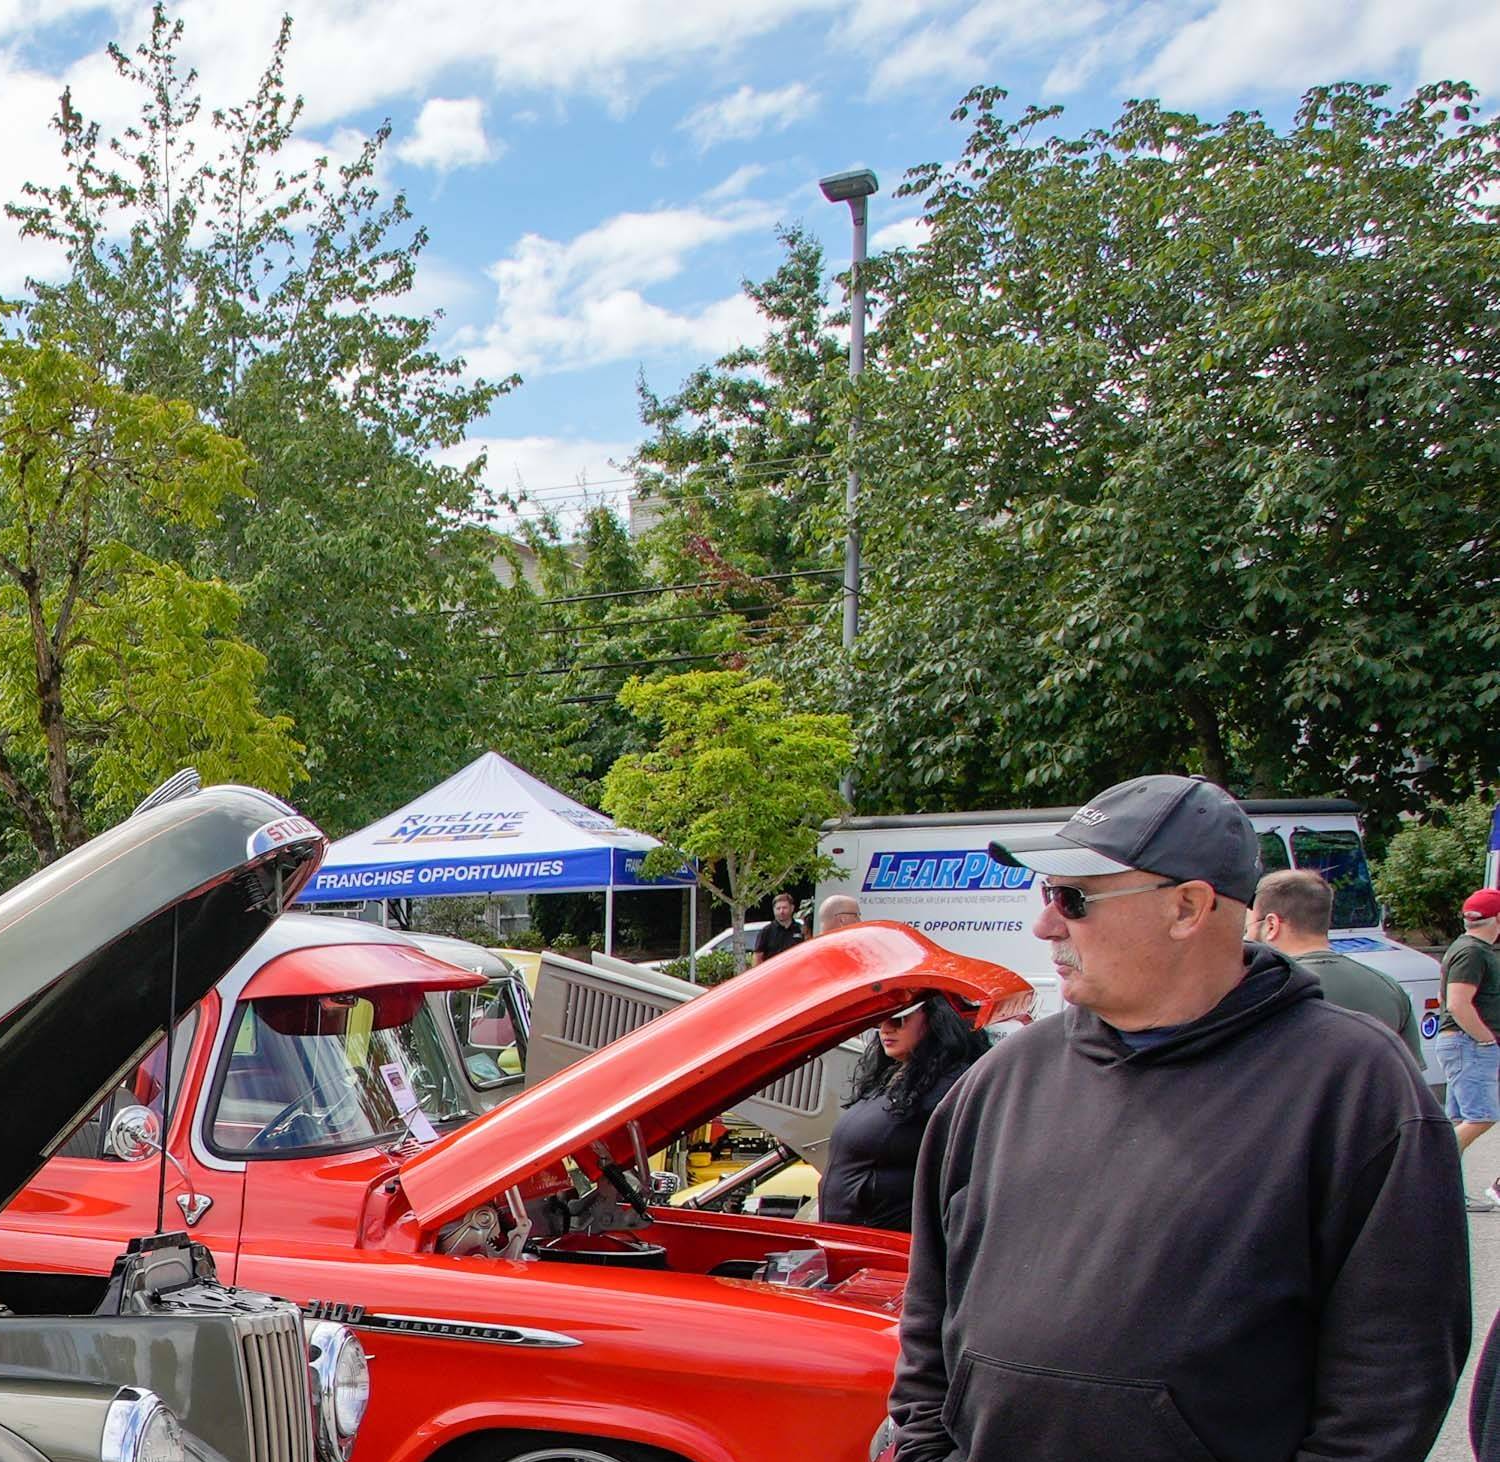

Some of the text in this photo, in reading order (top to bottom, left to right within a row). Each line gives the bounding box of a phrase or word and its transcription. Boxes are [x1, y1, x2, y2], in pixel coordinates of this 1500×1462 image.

[316, 860, 564, 890] FRANCHISE OPPORTUNITIES
[924, 921, 1023, 932] OPPORTUNITIES
[385, 1320, 506, 1339] CHEVROLET
